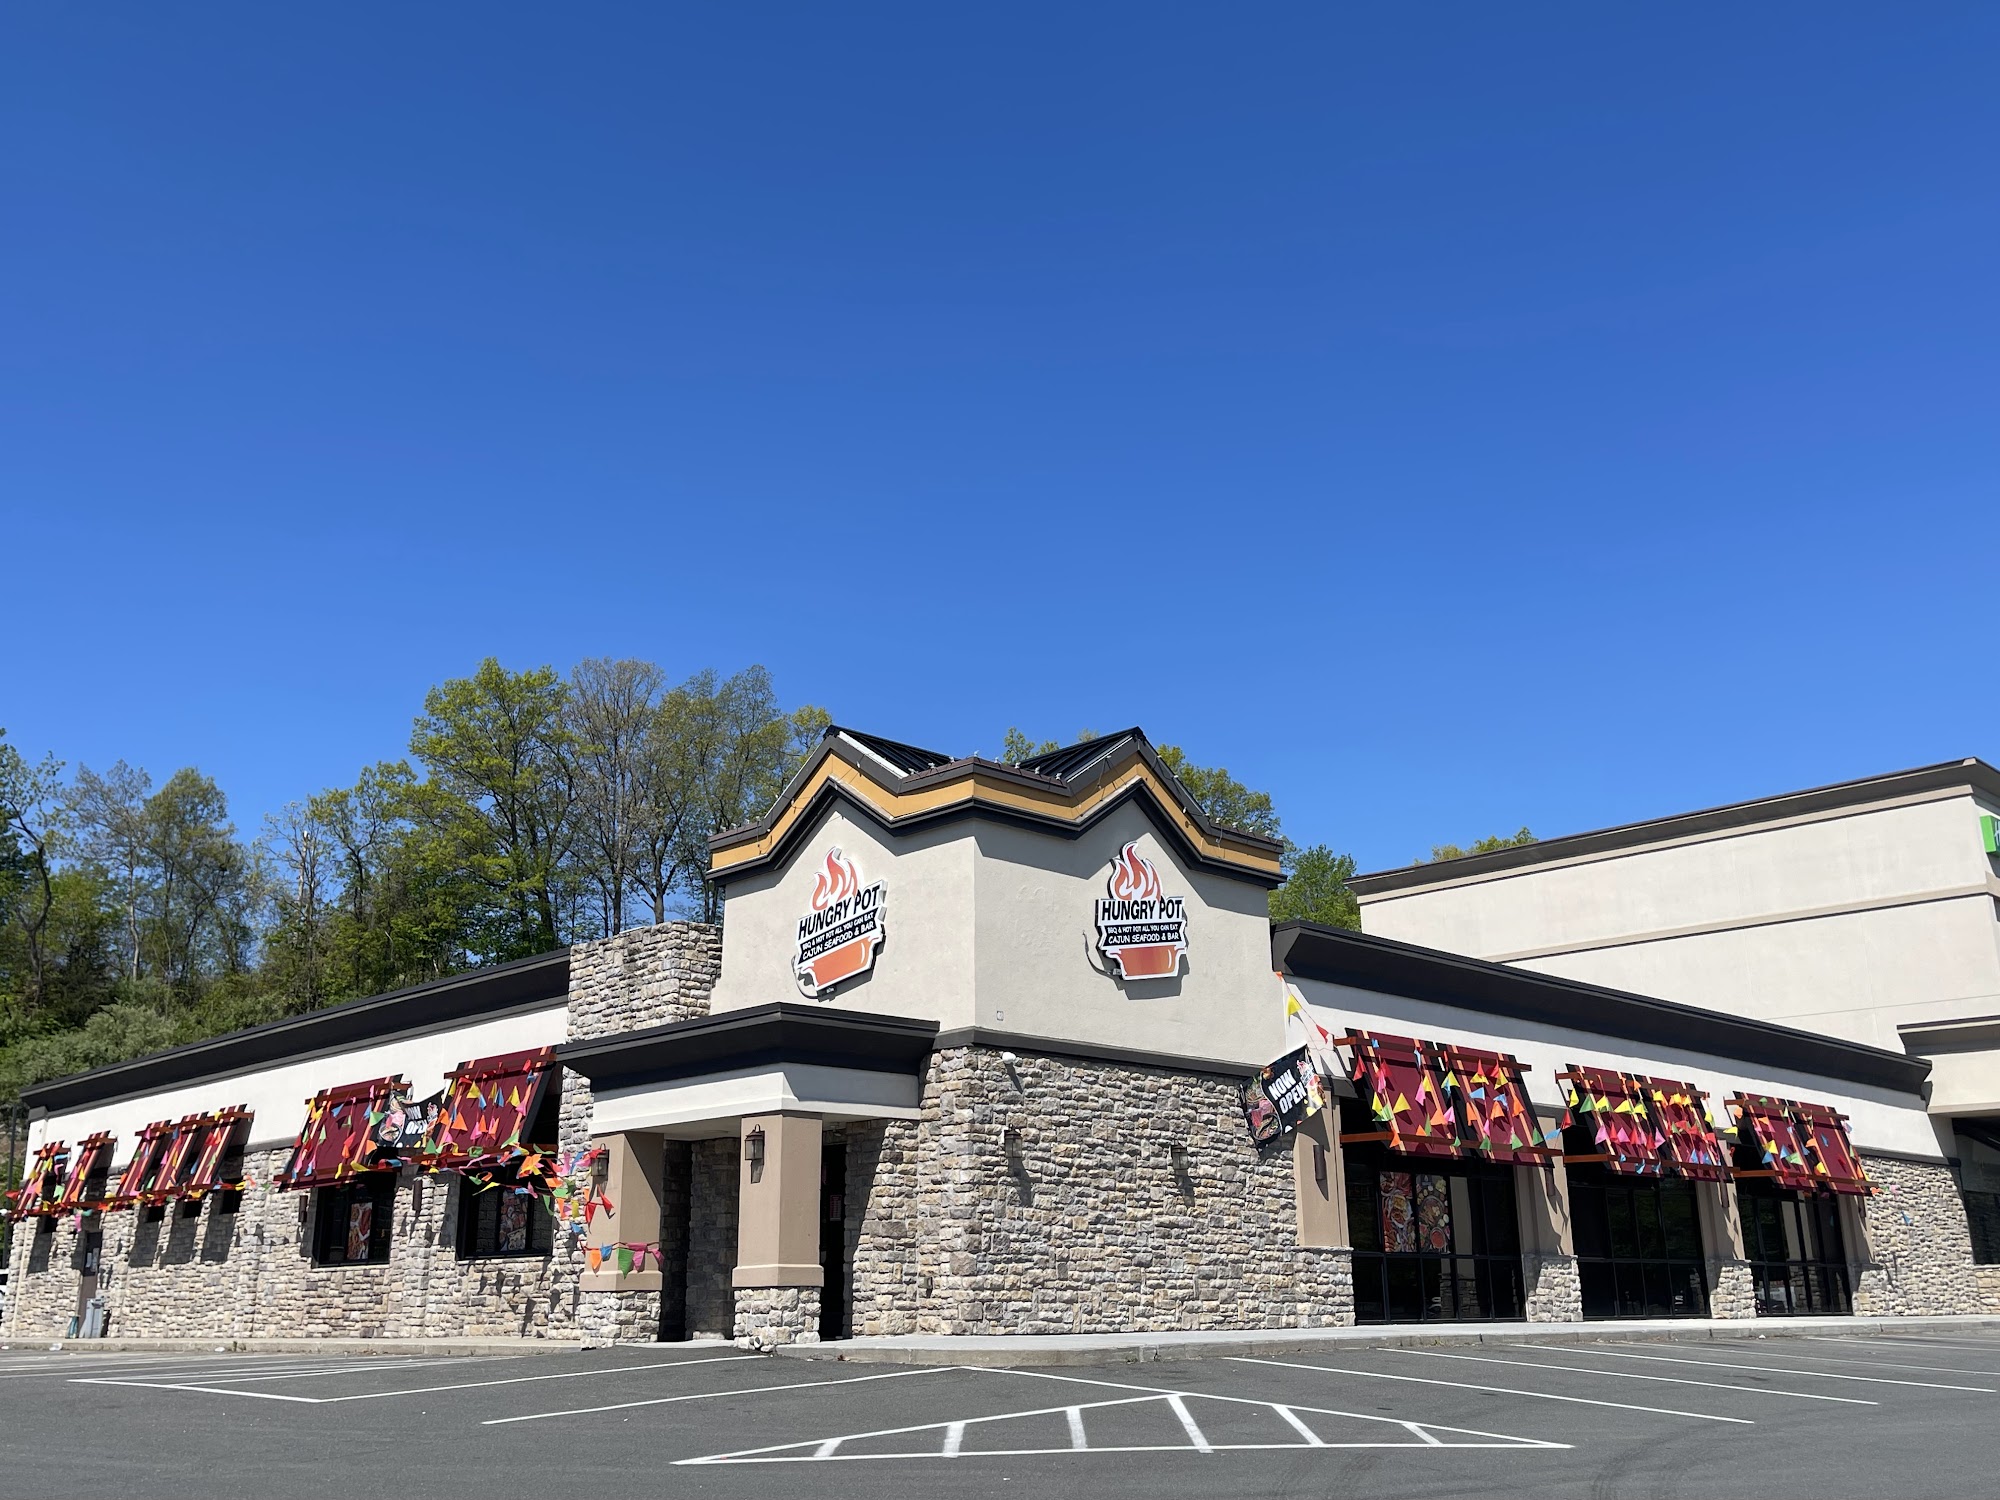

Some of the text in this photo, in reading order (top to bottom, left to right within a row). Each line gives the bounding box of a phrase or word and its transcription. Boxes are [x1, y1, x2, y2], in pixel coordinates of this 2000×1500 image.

[798, 884, 881, 940] HUNGRY POT
[1101, 899, 1182, 921] HUNGRY POT
[802, 941, 811, 951] BBQ
[815, 934, 825, 945] HOT
[825, 930, 835, 939] POT
[834, 926, 843, 935] ALL
[842, 921, 853, 931] YOU
[853, 916, 864, 926] CAN
[863, 911, 874, 921] EAT
[802, 921, 874, 960] CAJUN SEAFOOD & BAR
[1107, 926, 1118, 935] BBQ
[1122, 925, 1132, 933] HOT
[1132, 925, 1141, 933] POT
[1141, 924, 1150, 932] ALL
[1150, 924, 1160, 932] YOU
[1169, 923, 1179, 931] EAT
[1108, 932, 1180, 944] CAJUN SEAFOOD & BAR
[1268, 1068, 1296, 1101] NOW
[1278, 1081, 1307, 1114] OPEN
